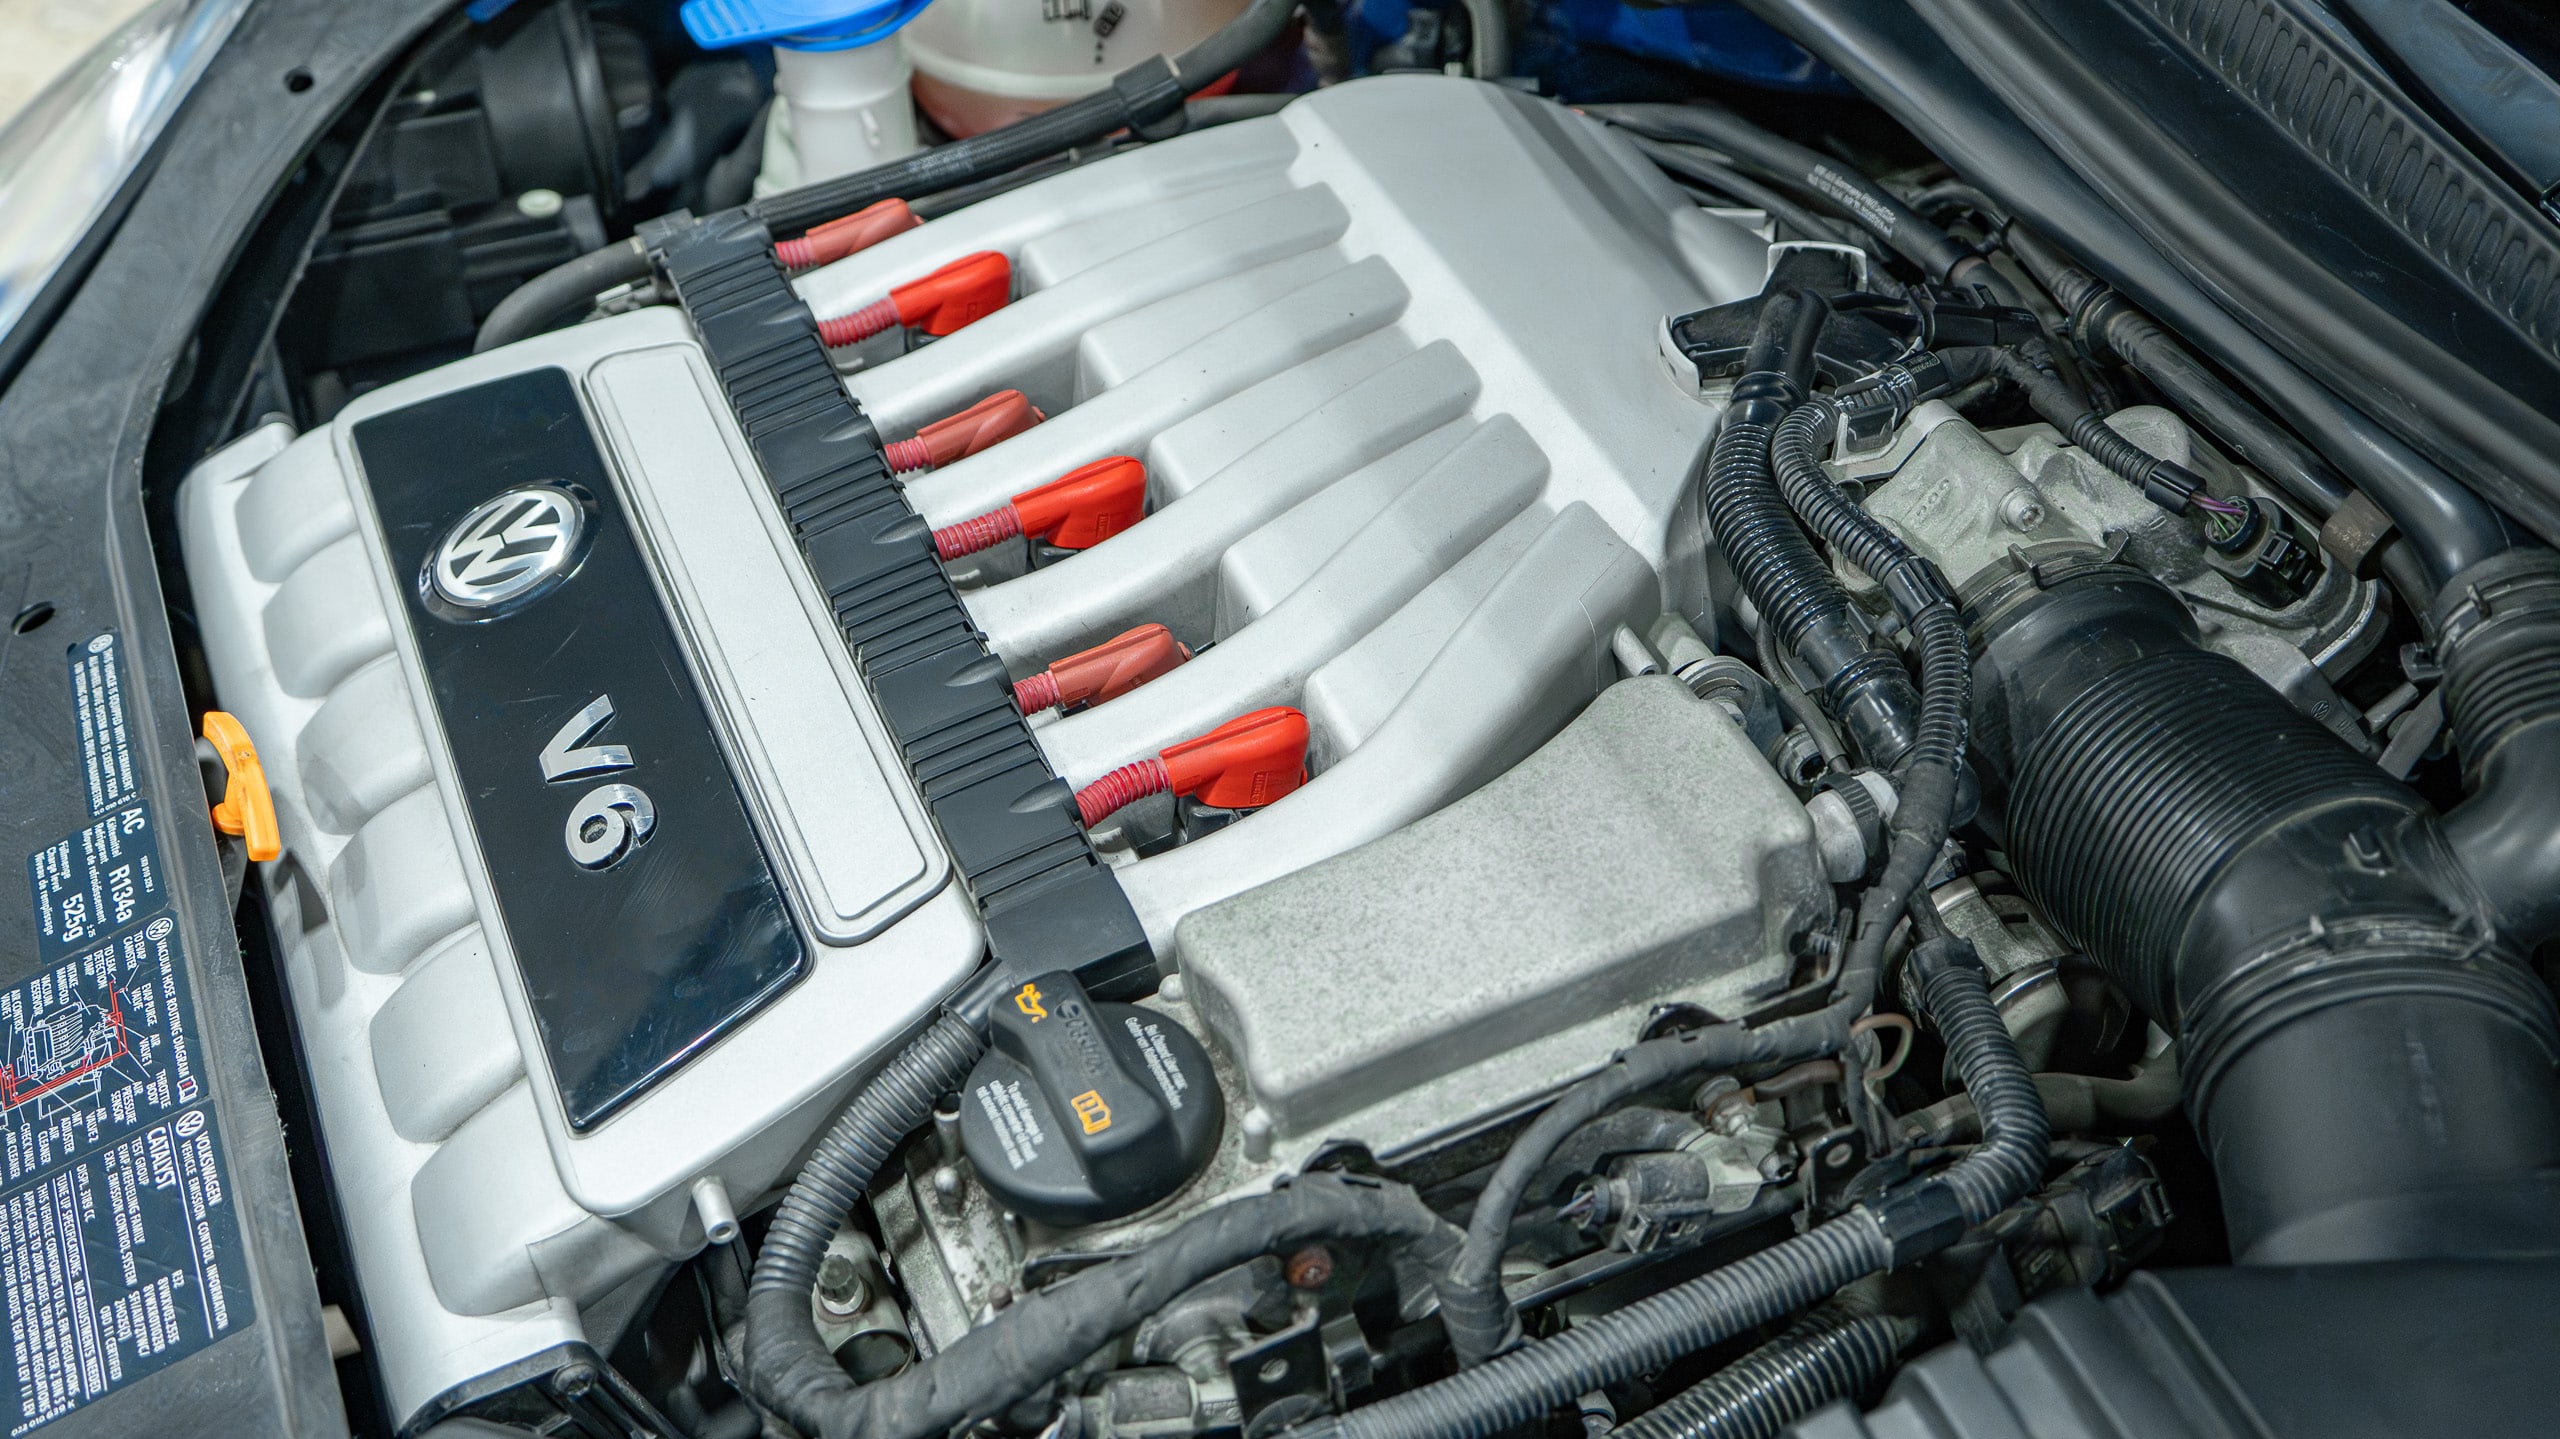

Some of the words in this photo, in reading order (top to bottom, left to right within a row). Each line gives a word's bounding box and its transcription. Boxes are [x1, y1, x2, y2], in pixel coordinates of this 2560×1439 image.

[95, 705, 107, 730] SYSTEM
[109, 694, 123, 726] EQUIPPED
[99, 730, 110, 745] AND
[114, 724, 126, 744] WITH
[102, 744, 111, 752] IS
[102, 752, 115, 778] EXEMPT
[118, 750, 134, 791] PERMANENT
[107, 778, 118, 799] FROM
[539, 693, 658, 872] V6
[121, 808, 145, 834] AC
[82, 828, 93, 855] Moyen
[94, 822, 109, 864] Refrigerant
[106, 817, 122, 857] Kältemittel
[35, 852, 45, 879] Niveau
[47, 847, 57, 873] Charge
[59, 840, 71, 879] Füllmenge
[87, 855, 96, 865] de
[39, 880, 48, 890] de
[51, 873, 62, 892] level
[89, 866, 107, 924] refroidissement
[109, 864, 135, 923] R134a
[40, 890, 53, 936] remplissage
[63, 893, 90, 942] 525g
[134, 930, 143, 942] TO
[104, 944, 114, 956] TO
[123, 936, 137, 970] CANISTER
[135, 941, 146, 959] EVAP
[157, 938, 172, 975] VACUUM
[67, 962, 79, 988] INTAKE
[83, 954, 95, 975] PUMP
[94, 950, 108, 989] DETECTION
[106, 955, 117, 974] LEAK
[11, 989, 21, 1002] AIR
[31, 979, 43, 1017] RESERVOIR
[41, 974, 53, 1006] VACUUM
[56, 967, 69, 1005] MANIFOLD
[131, 987, 143, 1011] VALVE
[142, 983, 153, 1001] EVAP
[162, 974, 175, 998] HOSE
[1, 993, 11, 1016] VALVE
[12, 1001, 26, 1034] CONTROL
[145, 1001, 157, 1027] PURGE
[166, 997, 182, 1036] ROUTING
[139, 1037, 151, 1062] VALVE
[150, 1034, 161, 1048] AIR
[173, 1035, 189, 1078] DIAGRAM
[132, 1081, 143, 1096] AIR
[146, 1082, 159, 1105] BODY
[156, 1069, 171, 1109] THROTTLE
[96, 1108, 107, 1122] AIR
[111, 1090, 124, 1123] SENSOR
[122, 1085, 137, 1125] PRESSURE
[72, 1111, 83, 1127] IMT
[86, 1111, 98, 1137] VALVE
[176, 1111, 204, 1137] VW
[6, 1132, 16, 1146] AIR
[21, 1123, 32, 1149] CHECK
[49, 1126, 59, 1141] AIR
[61, 1117, 75, 1154] ADJUSTER
[89, 1135, 99, 1143] 2
[132, 1137, 144, 1156] TEST
[24, 1147, 35, 1173] VALVE
[38, 1131, 51, 1165] CLEANER
[104, 1150, 116, 1172] EXH.
[147, 1127, 176, 1189] CATALYST
[7, 1145, 20, 1179] CLEANER
[135, 1157, 149, 1185] GROUP
[195, 1131, 222, 1206] VOLKSWAGEN
[57, 1173, 69, 1197] TUNE
[77, 1164, 89, 1190] DISPL.
[37, 1183, 49, 1204] THIS
[60, 1196, 71, 1209] UP
[80, 1189, 93, 1209] 3189
[108, 1173, 124, 1214] EMISSION
[118, 1143, 140, 1214] EVAP./REFUELING
[130, 1213, 145, 1244] FAMILY
[10, 1196, 26, 1244] LIGHT-DUTY
[23, 1191, 40, 1238] APPLICABLE
[40, 1202, 55, 1238] VEHICLE
[84, 1209, 95, 1222] CC
[31, 1236, 41, 1251] TO
[59, 1210, 82, 1277] SPECIFICATIONS:
[115, 1213, 131, 1254] CONTROL
[181, 1140, 197, 1176] VEHICLE
[189, 1177, 206, 1220] EMISSION
[198, 1222, 214, 1264] CONTROL
[206, 1264, 228, 1329] INFORMATION
[2, 1250, 13, 1264] TO
[17, 1243, 32, 1282] VEHICLES
[32, 1250, 45, 1274] 2008
[45, 1238, 62, 1287] CONFORMS
[122, 1252, 137, 1286] SYSTEM
[4, 1264, 17, 1287] 2008
[74, 1280, 85, 1296] NO
[172, 1270, 184, 1288] R32
[22, 1283, 34, 1303] AND
[36, 1272, 49, 1306] MODEL
[53, 1285, 64, 1299] TO
[8, 1286, 21, 1320] MODEL
[41, 1303, 53, 1328] YEAR
[55, 1299, 67, 1318] U.S.
[100, 1306, 112, 1326] OBD
[12, 1317, 25, 1342] YEAR
[25, 1303, 41, 1354] CALIFORNIA
[44, 1327, 57, 1350] NEW
[58, 1317, 69, 1335] EPA
[72, 1296, 95, 1358] ADJUSTMENTS
[15, 1341, 28, 1364] NEW
[47, 1349, 60, 1371] TIER
[60, 1334, 80, 1396] REGULATIONS
[105, 1337, 122, 1380] CERTIFIED
[18, 1364, 30, 1382] LEV
[32, 1352, 51, 1413] REGULATIONS
[50, 1370, 61, 1379] 2
[83, 1356, 101, 1394] NEEDED
[51, 1378, 64, 1398] BIN
[23, 1398, 35, 1416] LEV
